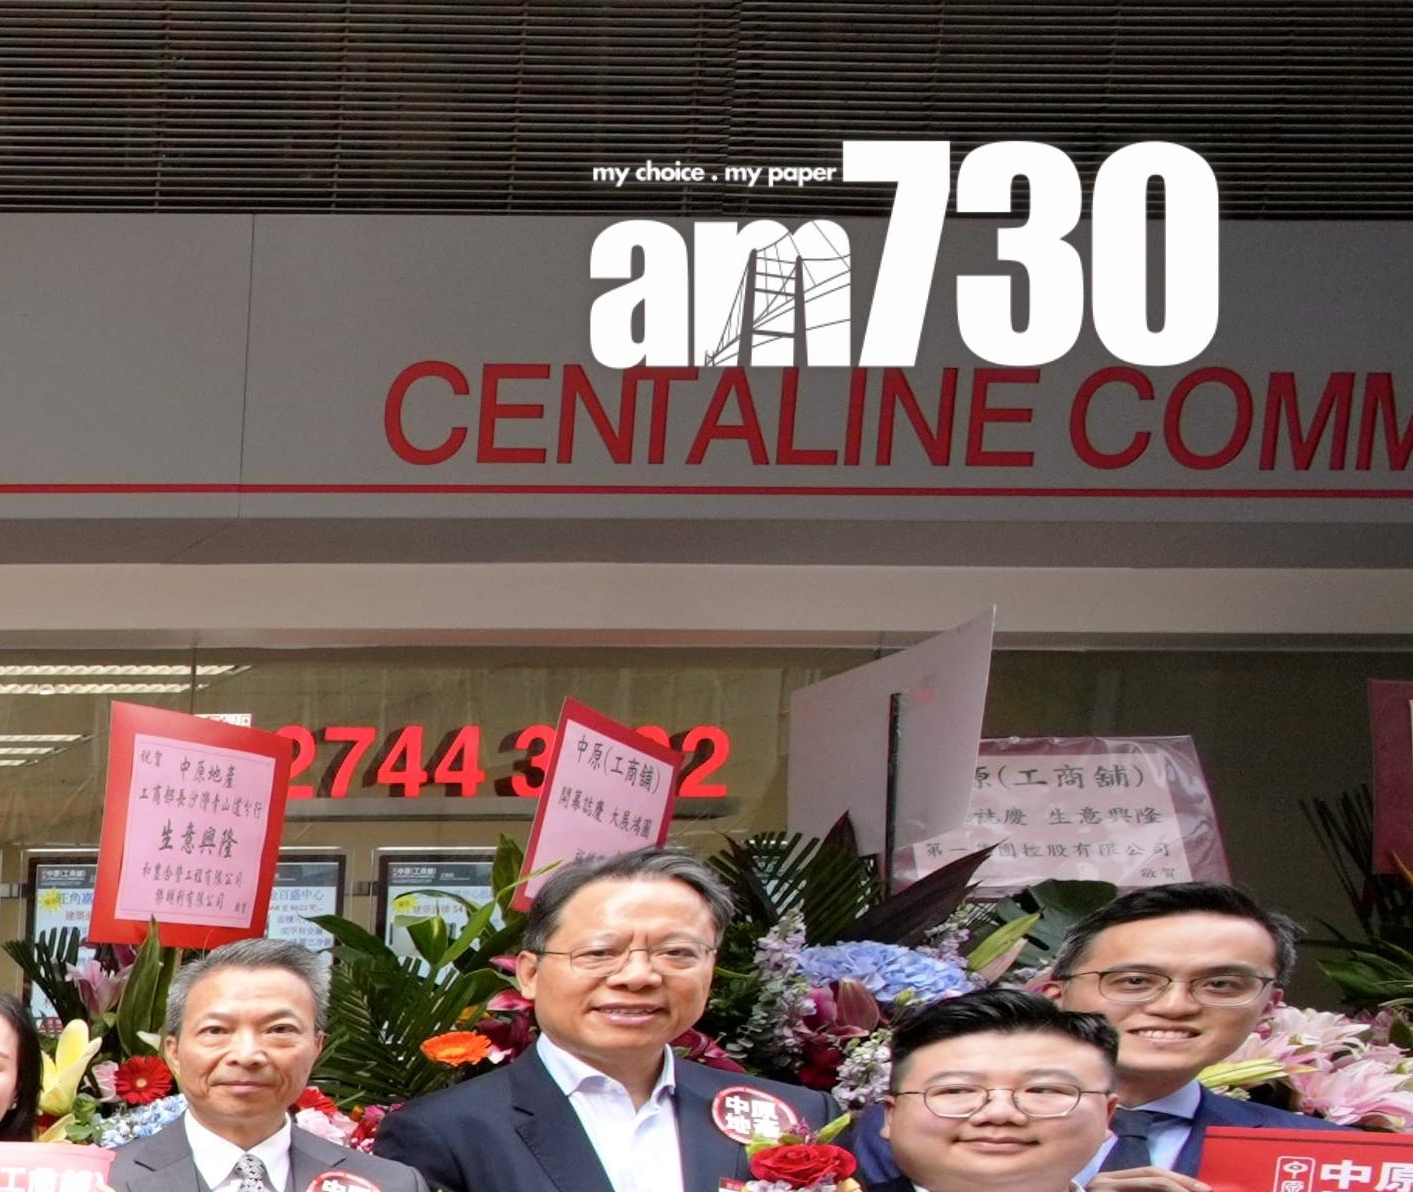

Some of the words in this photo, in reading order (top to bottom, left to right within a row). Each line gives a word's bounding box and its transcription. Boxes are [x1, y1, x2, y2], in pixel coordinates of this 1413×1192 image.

[383, 360, 1041, 468] CENTALINE
[1049, 806, 1163, 826] 生意興隆
[159, 818, 238, 859] 生意興隆
